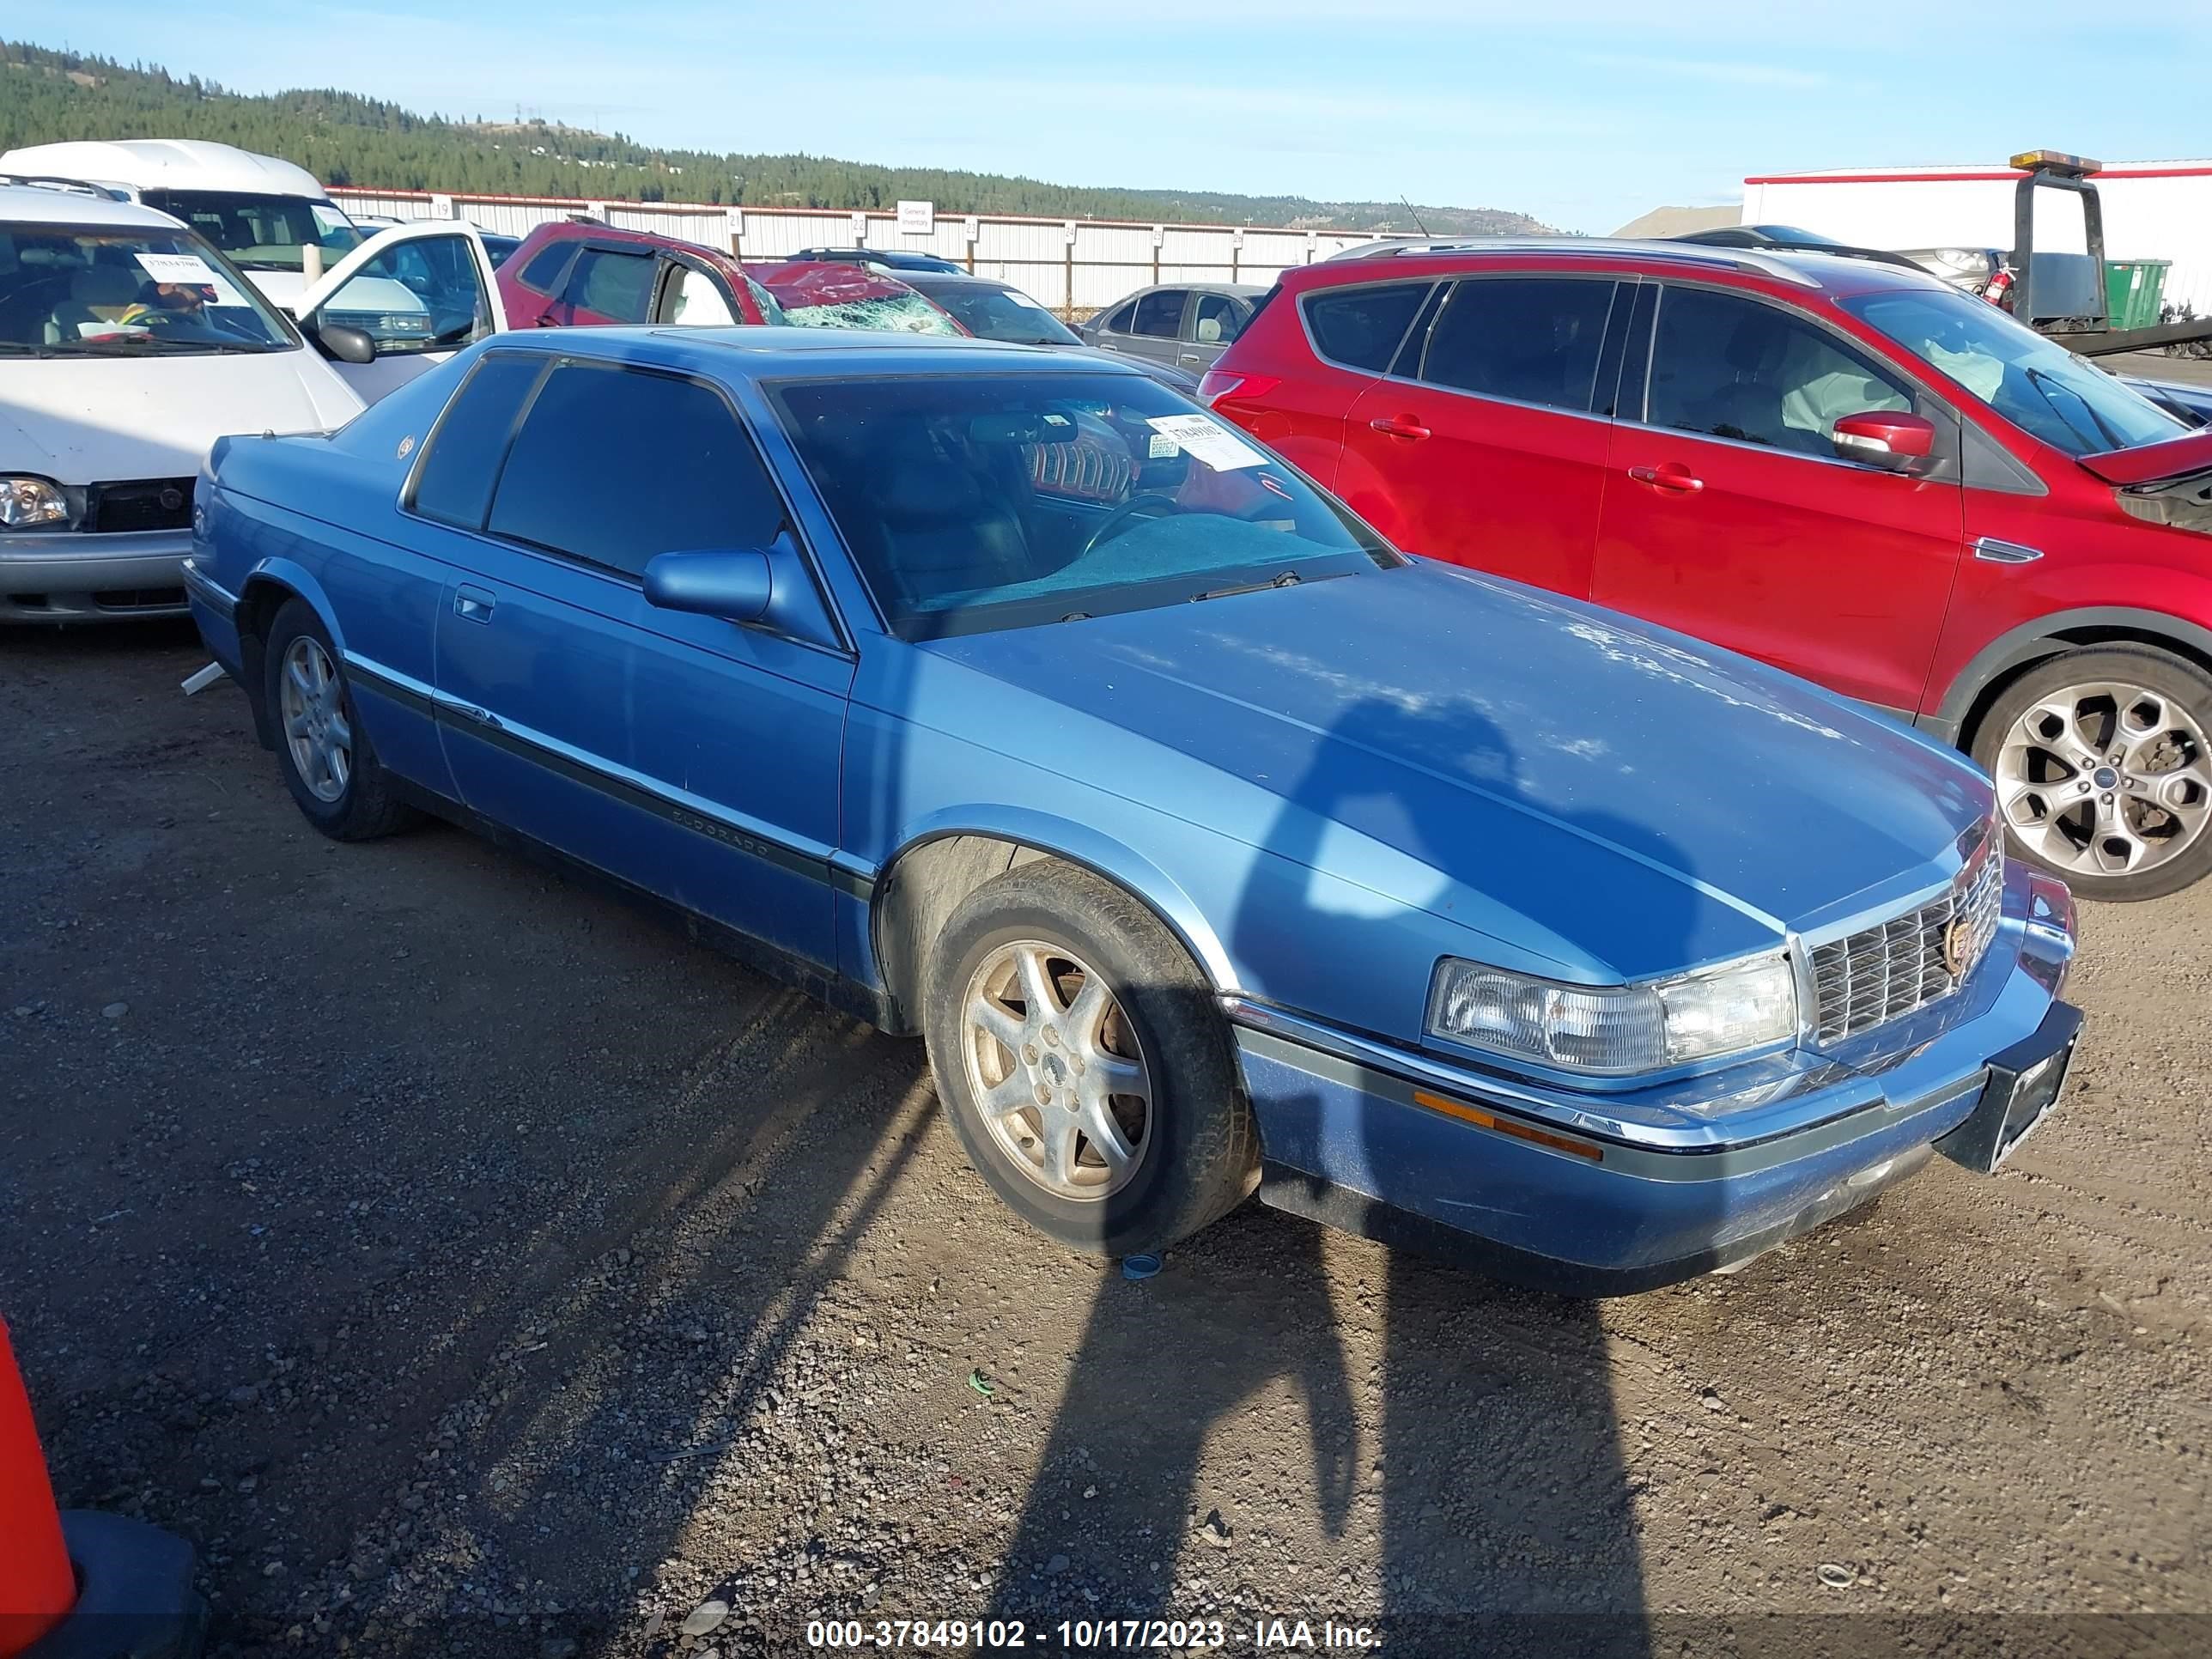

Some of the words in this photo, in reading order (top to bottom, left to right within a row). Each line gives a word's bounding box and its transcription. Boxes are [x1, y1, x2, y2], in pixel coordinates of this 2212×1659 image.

[436, 204, 448, 215] 19
[729, 215, 740, 227] 21
[853, 219, 864, 230] 22
[902, 218, 928, 227] Inventory
[966, 223, 976, 234] 23
[1065, 227, 1074, 237] 24
[1168, 425, 1221, 440] 37849102
[673, 811, 768, 855] ELDORADO
